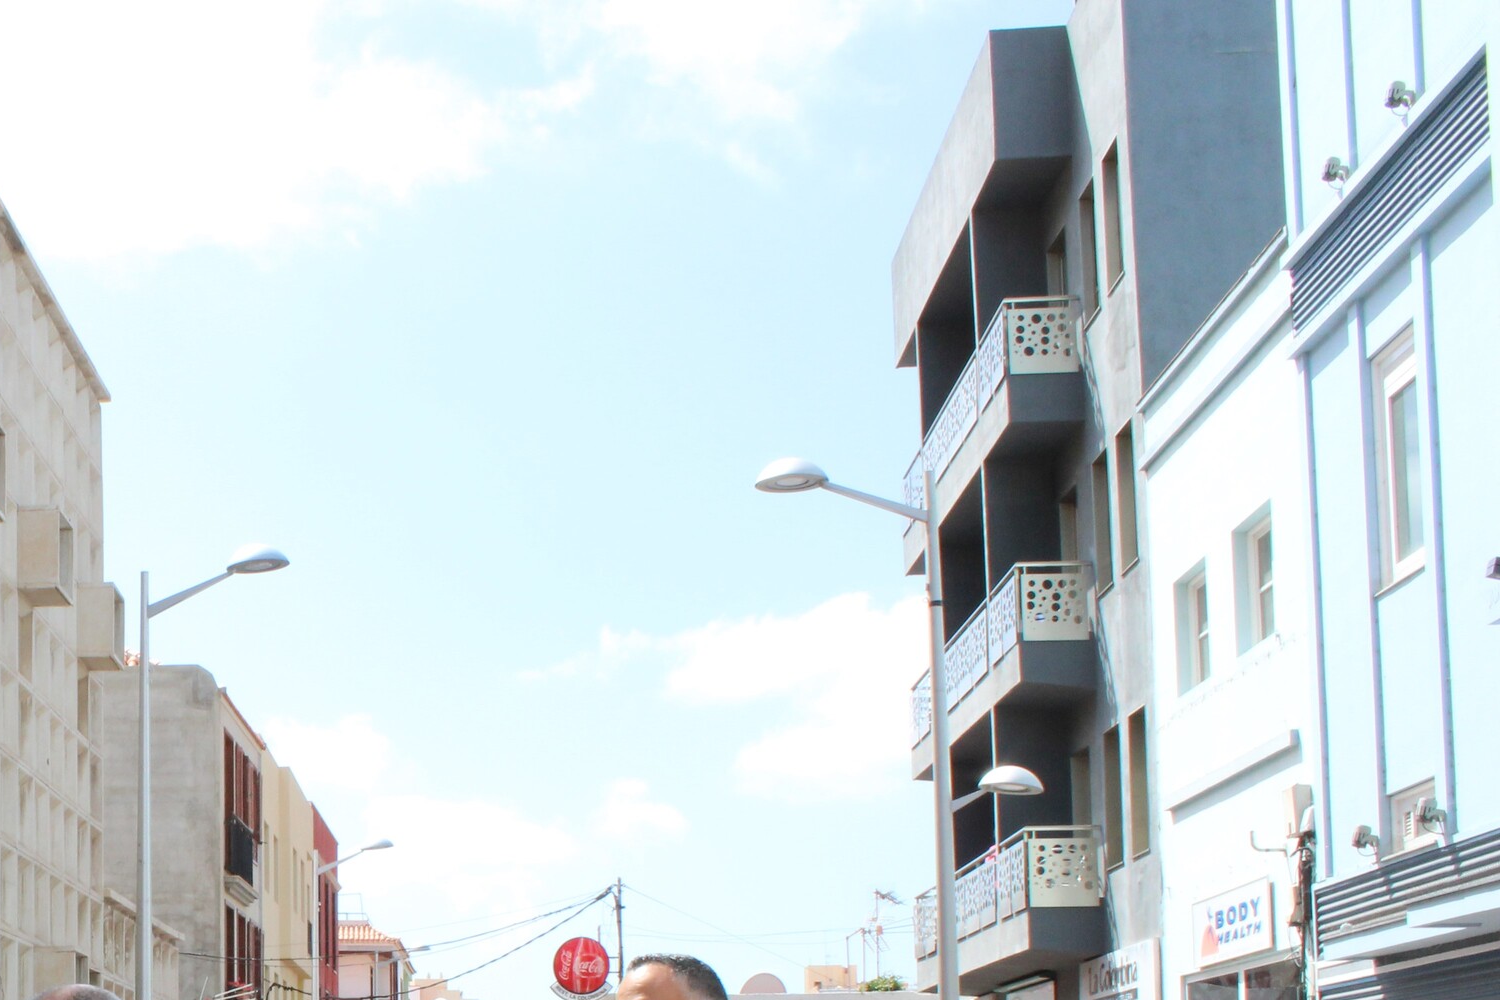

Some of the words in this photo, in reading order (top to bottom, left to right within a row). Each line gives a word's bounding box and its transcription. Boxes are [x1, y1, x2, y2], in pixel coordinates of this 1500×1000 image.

[1215, 896, 1260, 929] BODY
[1216, 920, 1261, 946] HEALTH
[1088, 967, 1098, 996] La
